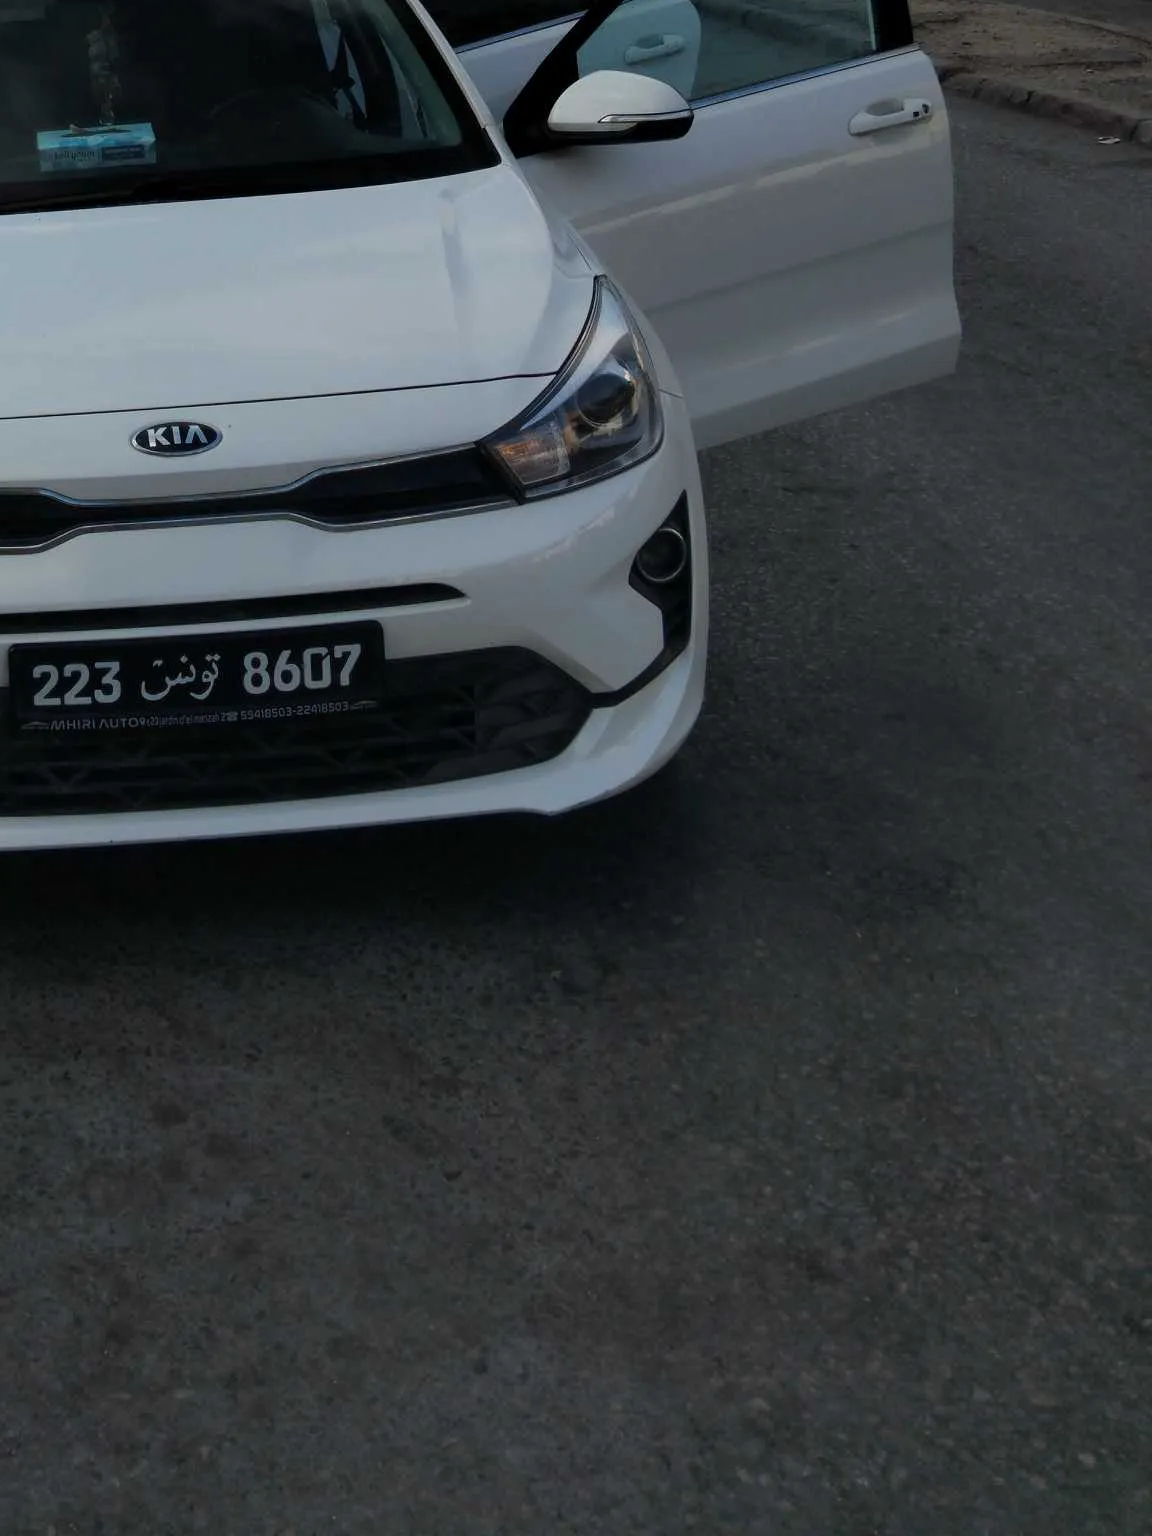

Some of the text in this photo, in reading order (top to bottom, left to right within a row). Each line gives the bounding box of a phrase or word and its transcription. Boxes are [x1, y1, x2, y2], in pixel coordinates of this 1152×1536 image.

[147, 424, 209, 448] KIA
[32, 661, 122, 706] 223
[141, 653, 222, 701] تونس
[243, 643, 362, 695] 8607
[50, 719, 96, 730] MHIRI
[98, 717, 139, 729] AUTO
